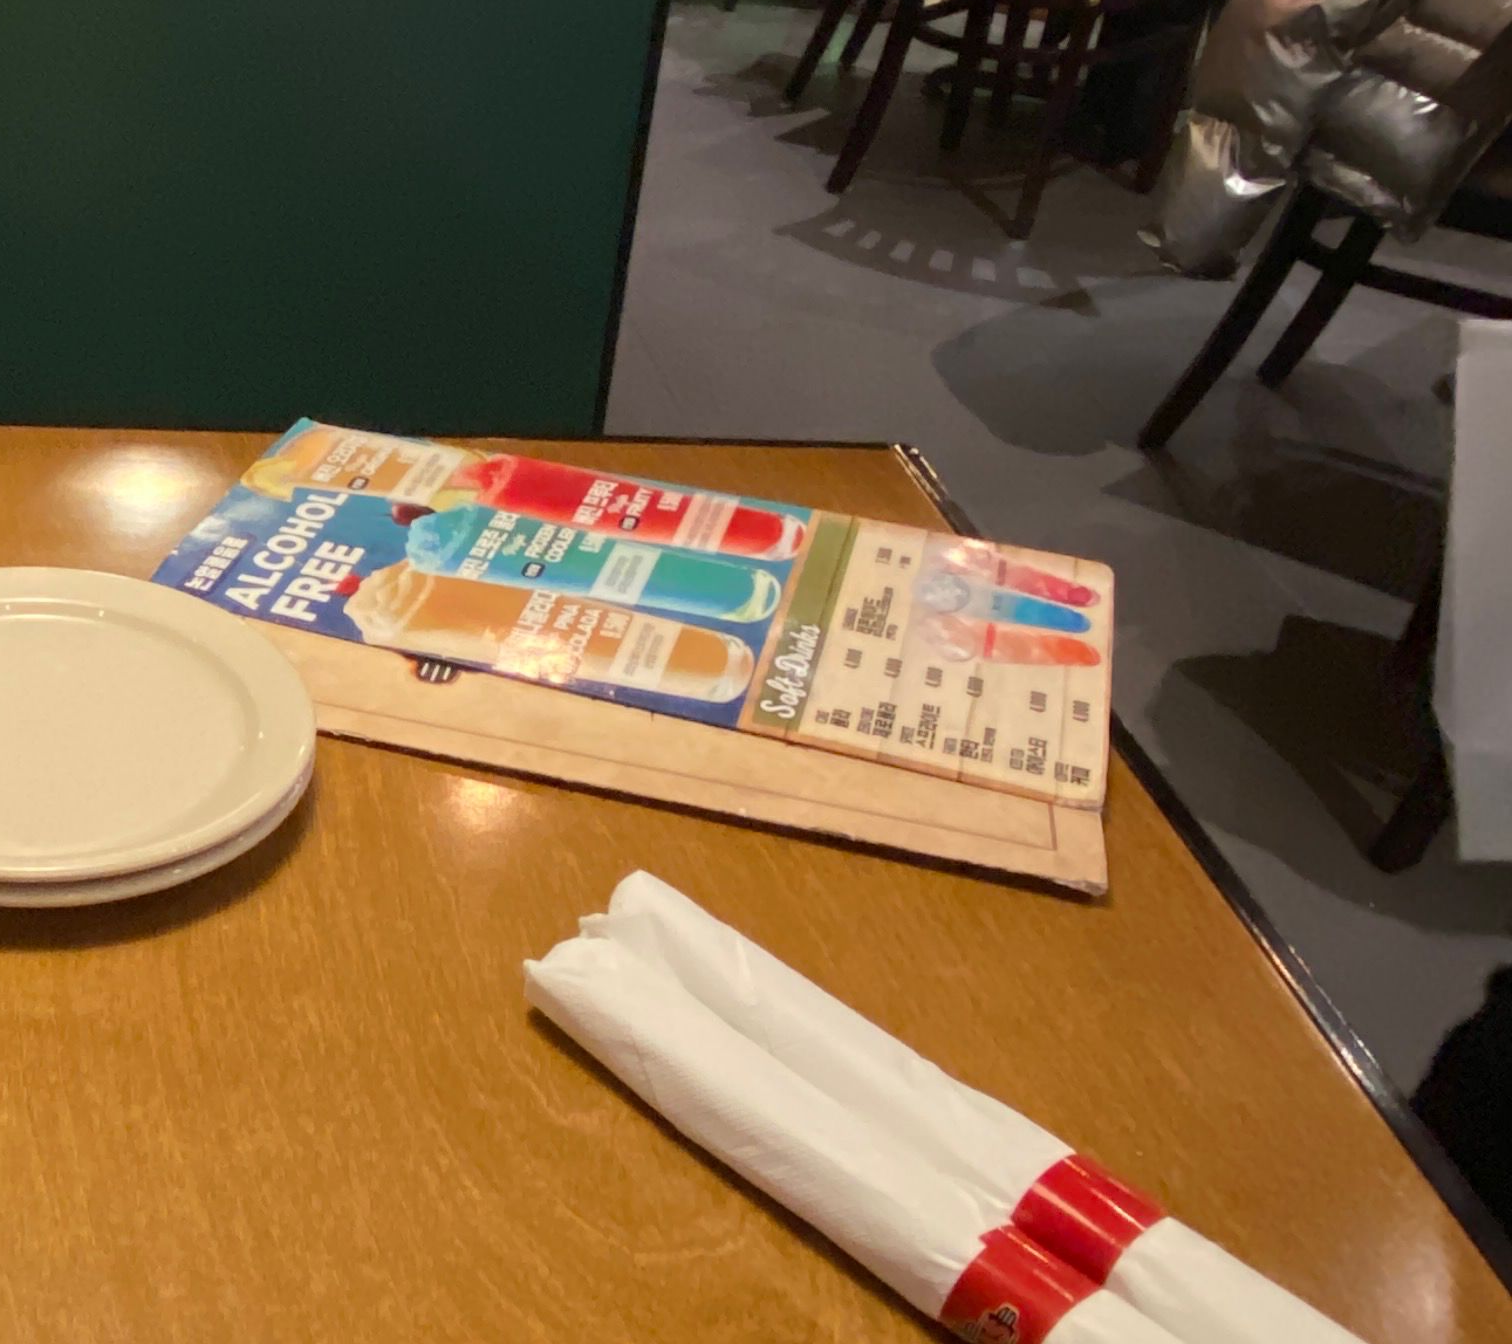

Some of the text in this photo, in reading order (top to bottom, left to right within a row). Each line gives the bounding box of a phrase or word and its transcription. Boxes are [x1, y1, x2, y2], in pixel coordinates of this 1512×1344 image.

[225, 494, 349, 610] ALCOHOL
[524, 522, 558, 558] FROZEN
[544, 528, 578, 562] COOLER
[270, 541, 365, 622] FREE
[568, 608, 603, 655] COLADA
[760, 624, 820, 718] Soft Drinks
[916, 703, 942, 749] 스프라이트
